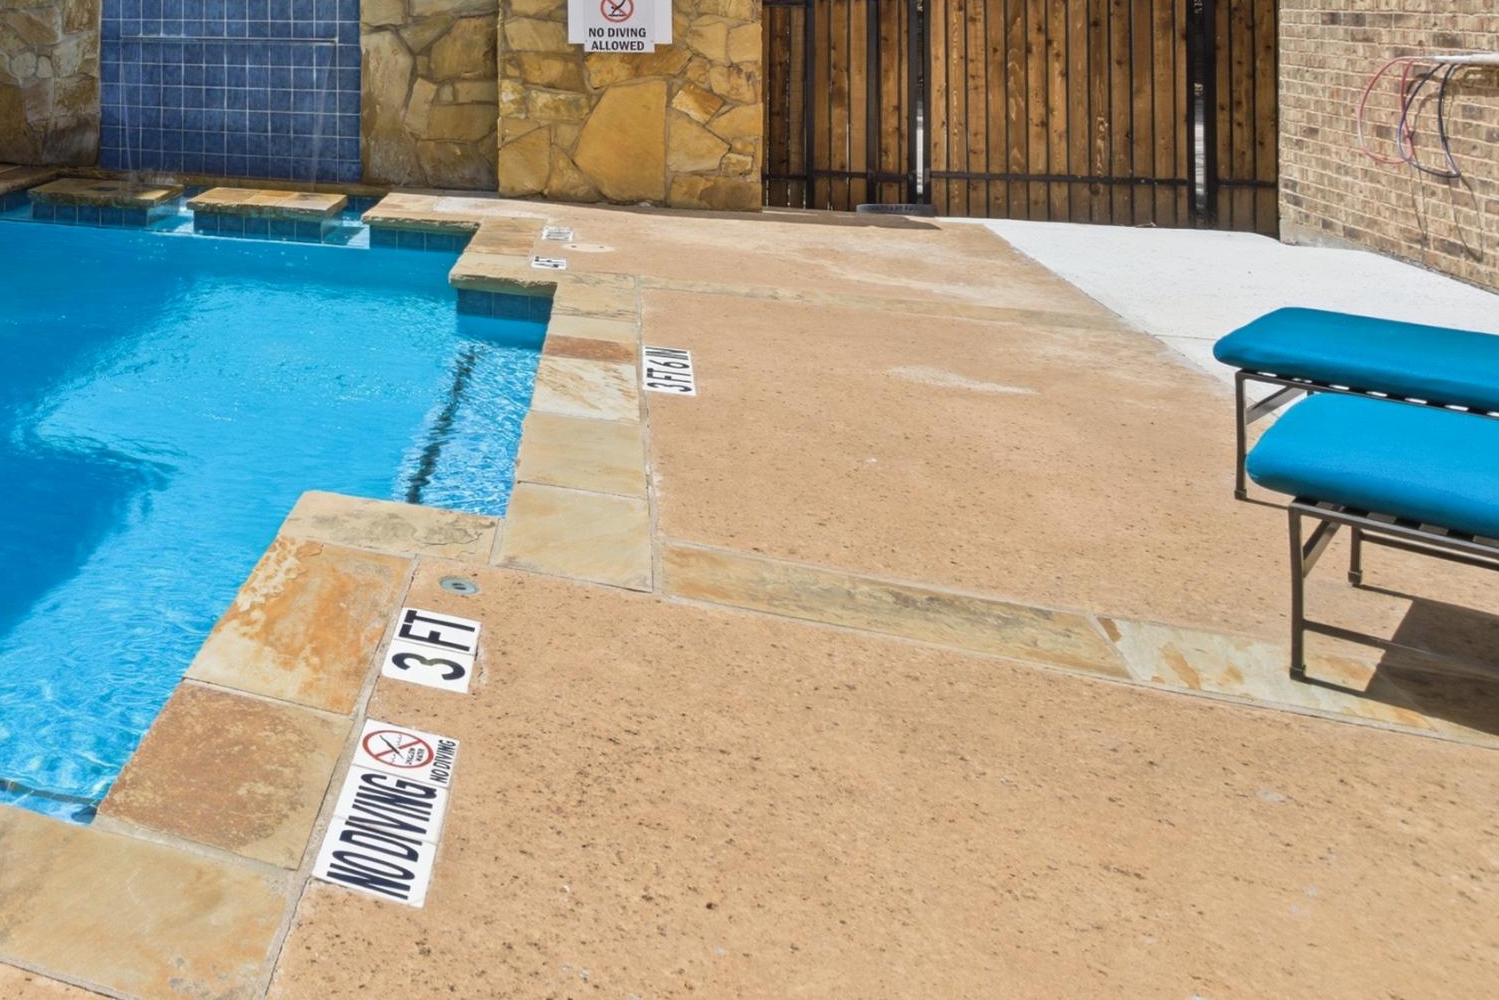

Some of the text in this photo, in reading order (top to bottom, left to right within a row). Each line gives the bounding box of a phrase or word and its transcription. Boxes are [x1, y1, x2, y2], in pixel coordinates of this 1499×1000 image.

[588, 27, 647, 38] NO DIVING
[591, 40, 645, 51] ALLOWED
[645, 346, 692, 393] 3 FT 6 IN
[391, 609, 476, 681] 3 FT
[429, 739, 457, 784] NO DIVING
[326, 773, 438, 901] NO DIVING
